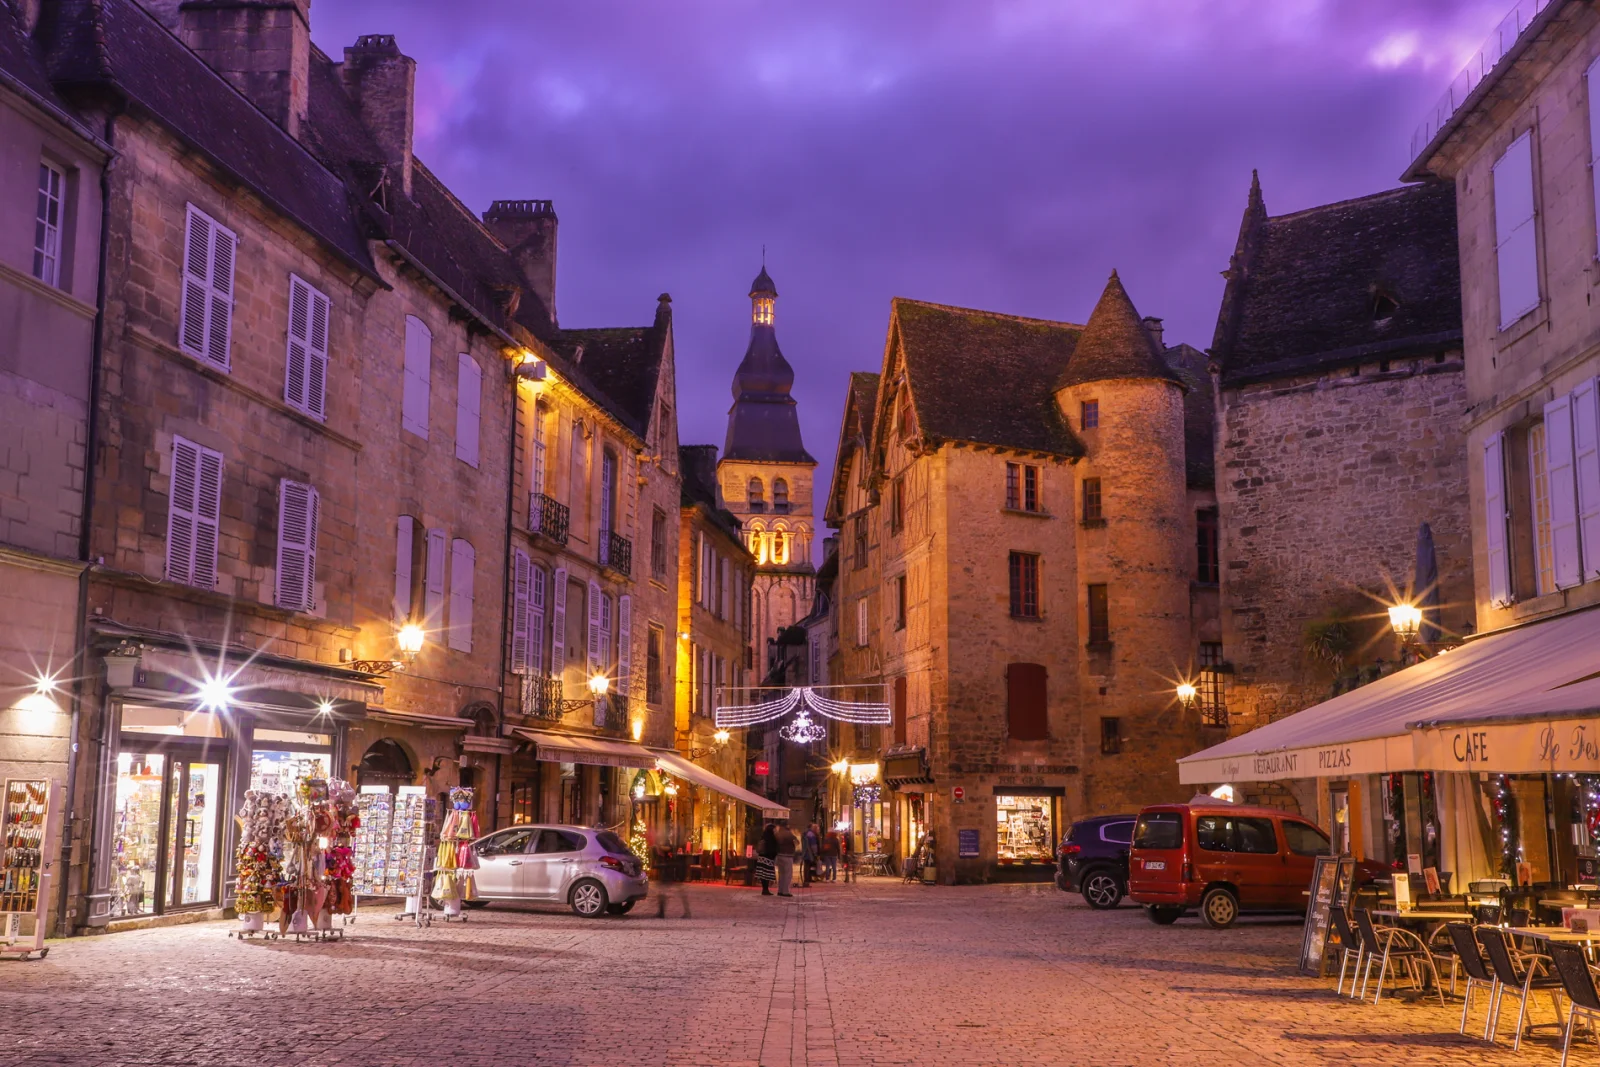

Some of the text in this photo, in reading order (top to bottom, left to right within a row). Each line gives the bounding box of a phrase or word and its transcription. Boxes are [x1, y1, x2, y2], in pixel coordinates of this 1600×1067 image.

[1318, 748, 1351, 769] PIZZAS
[1453, 732, 1488, 762] CAFE
[1540, 727, 1560, 761] Le
